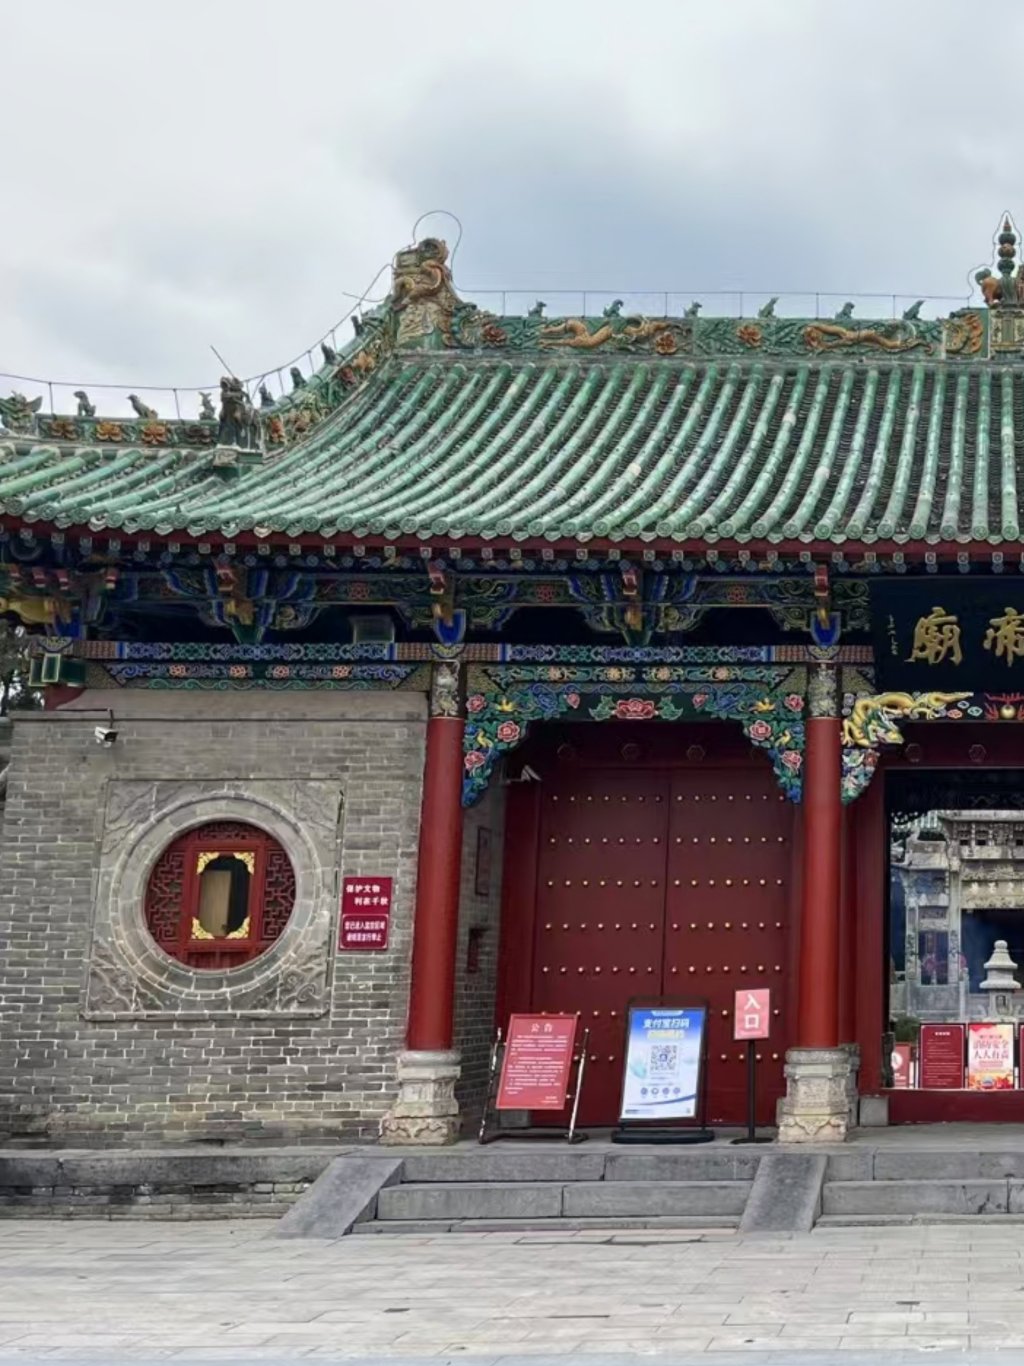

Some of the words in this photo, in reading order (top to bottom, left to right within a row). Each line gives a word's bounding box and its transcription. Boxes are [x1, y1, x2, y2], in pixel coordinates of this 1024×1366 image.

[346, 884, 380, 893] 保护文物
[744, 993, 760, 1029] 入口
[643, 1018, 690, 1029] 支付宝扫码
